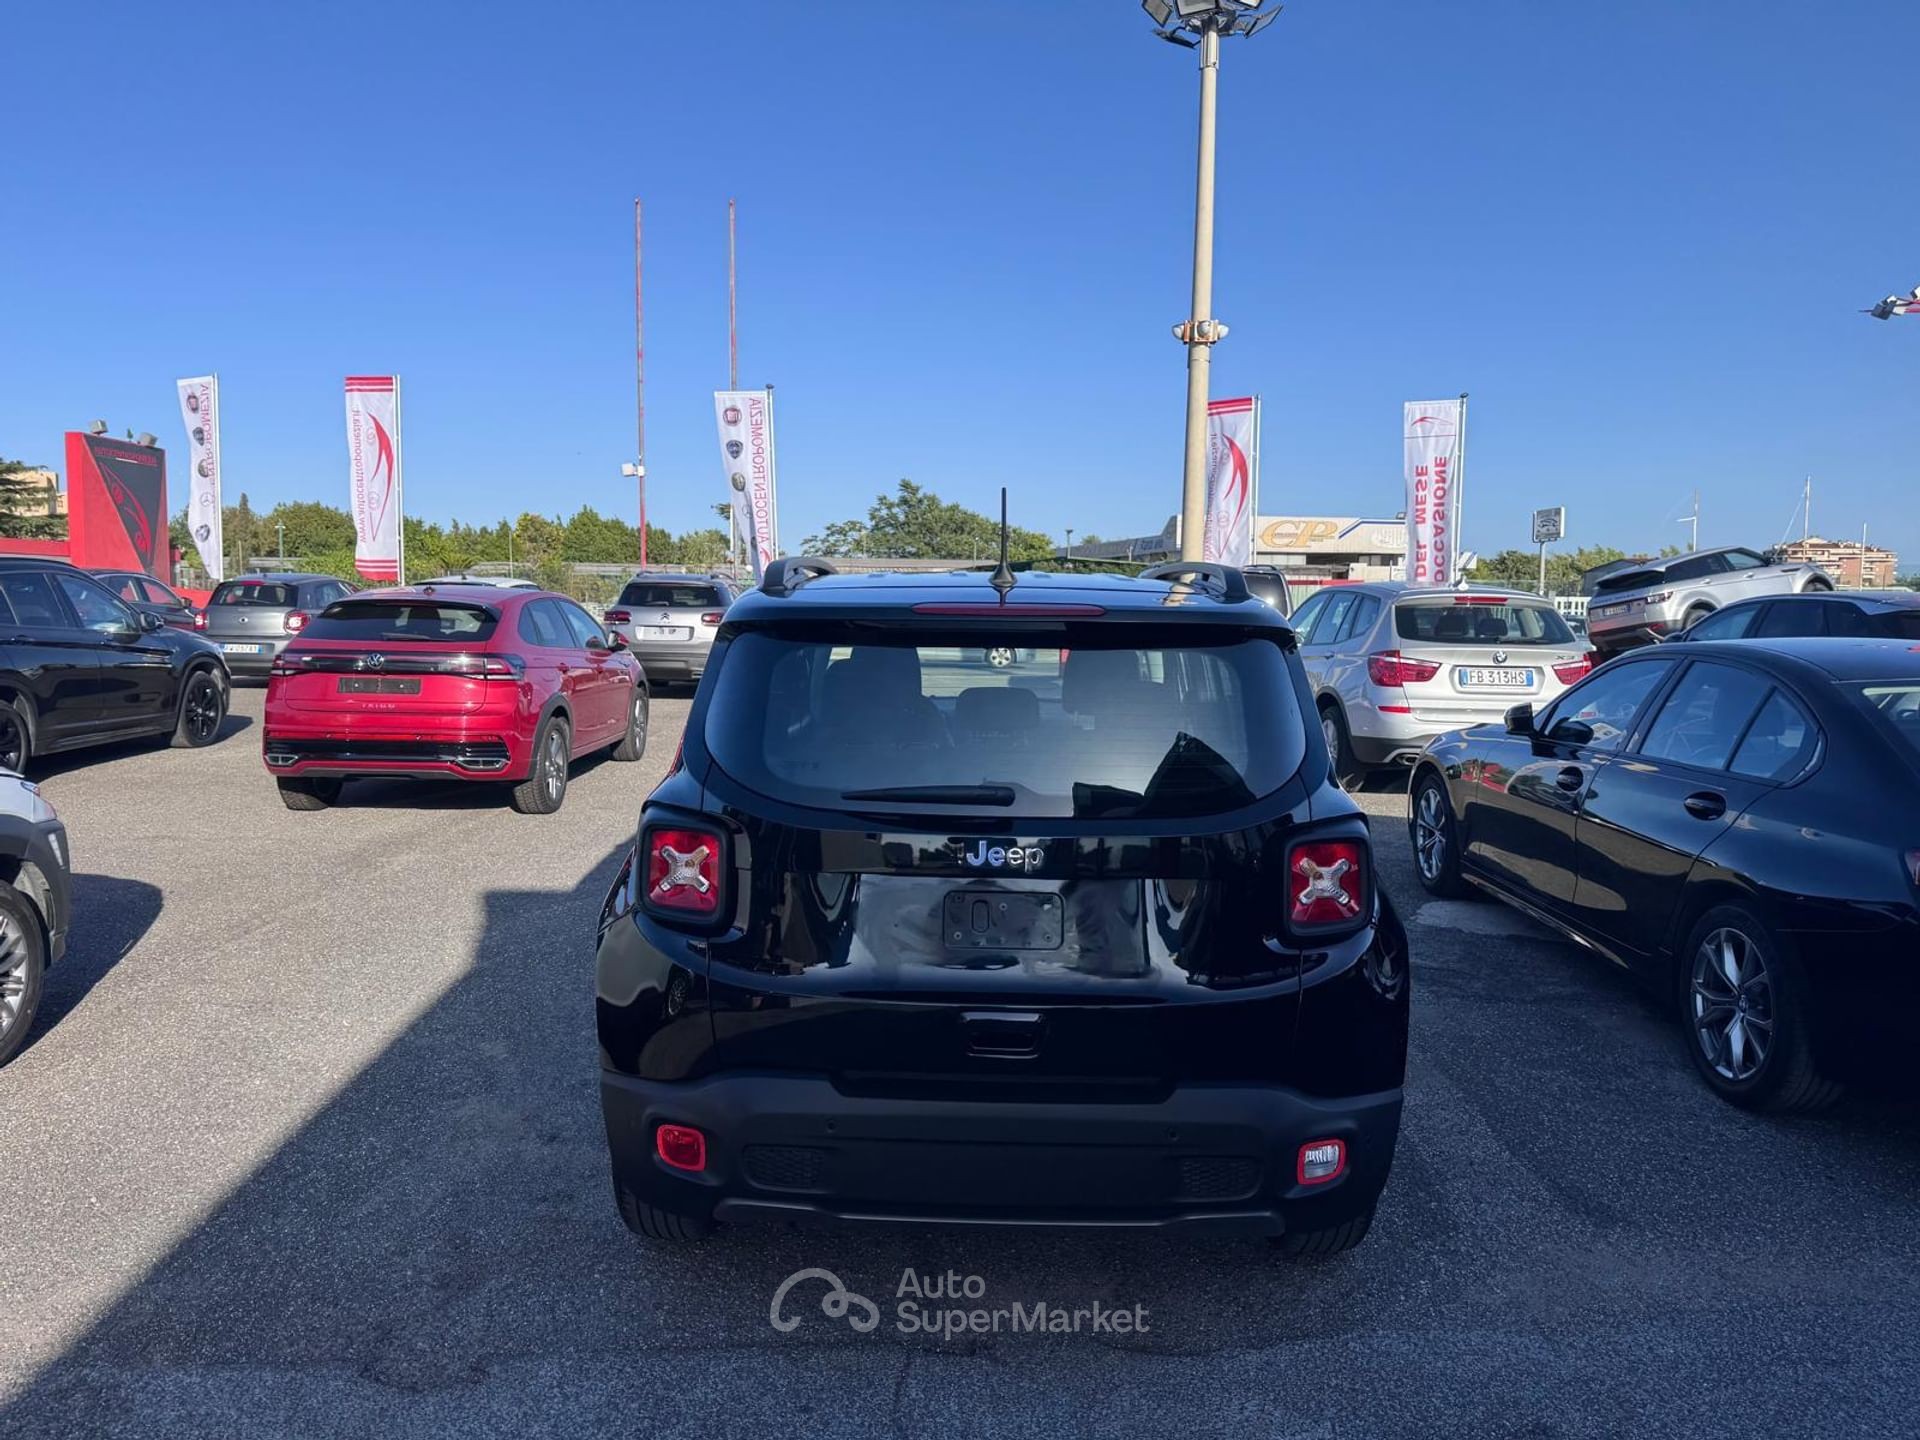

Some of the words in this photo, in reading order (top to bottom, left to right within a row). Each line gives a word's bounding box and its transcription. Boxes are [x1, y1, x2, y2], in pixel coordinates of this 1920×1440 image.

[1469, 670, 1484, 683] FB
[1488, 670, 1525, 684] 313HS
[966, 840, 1044, 872] Jeep
